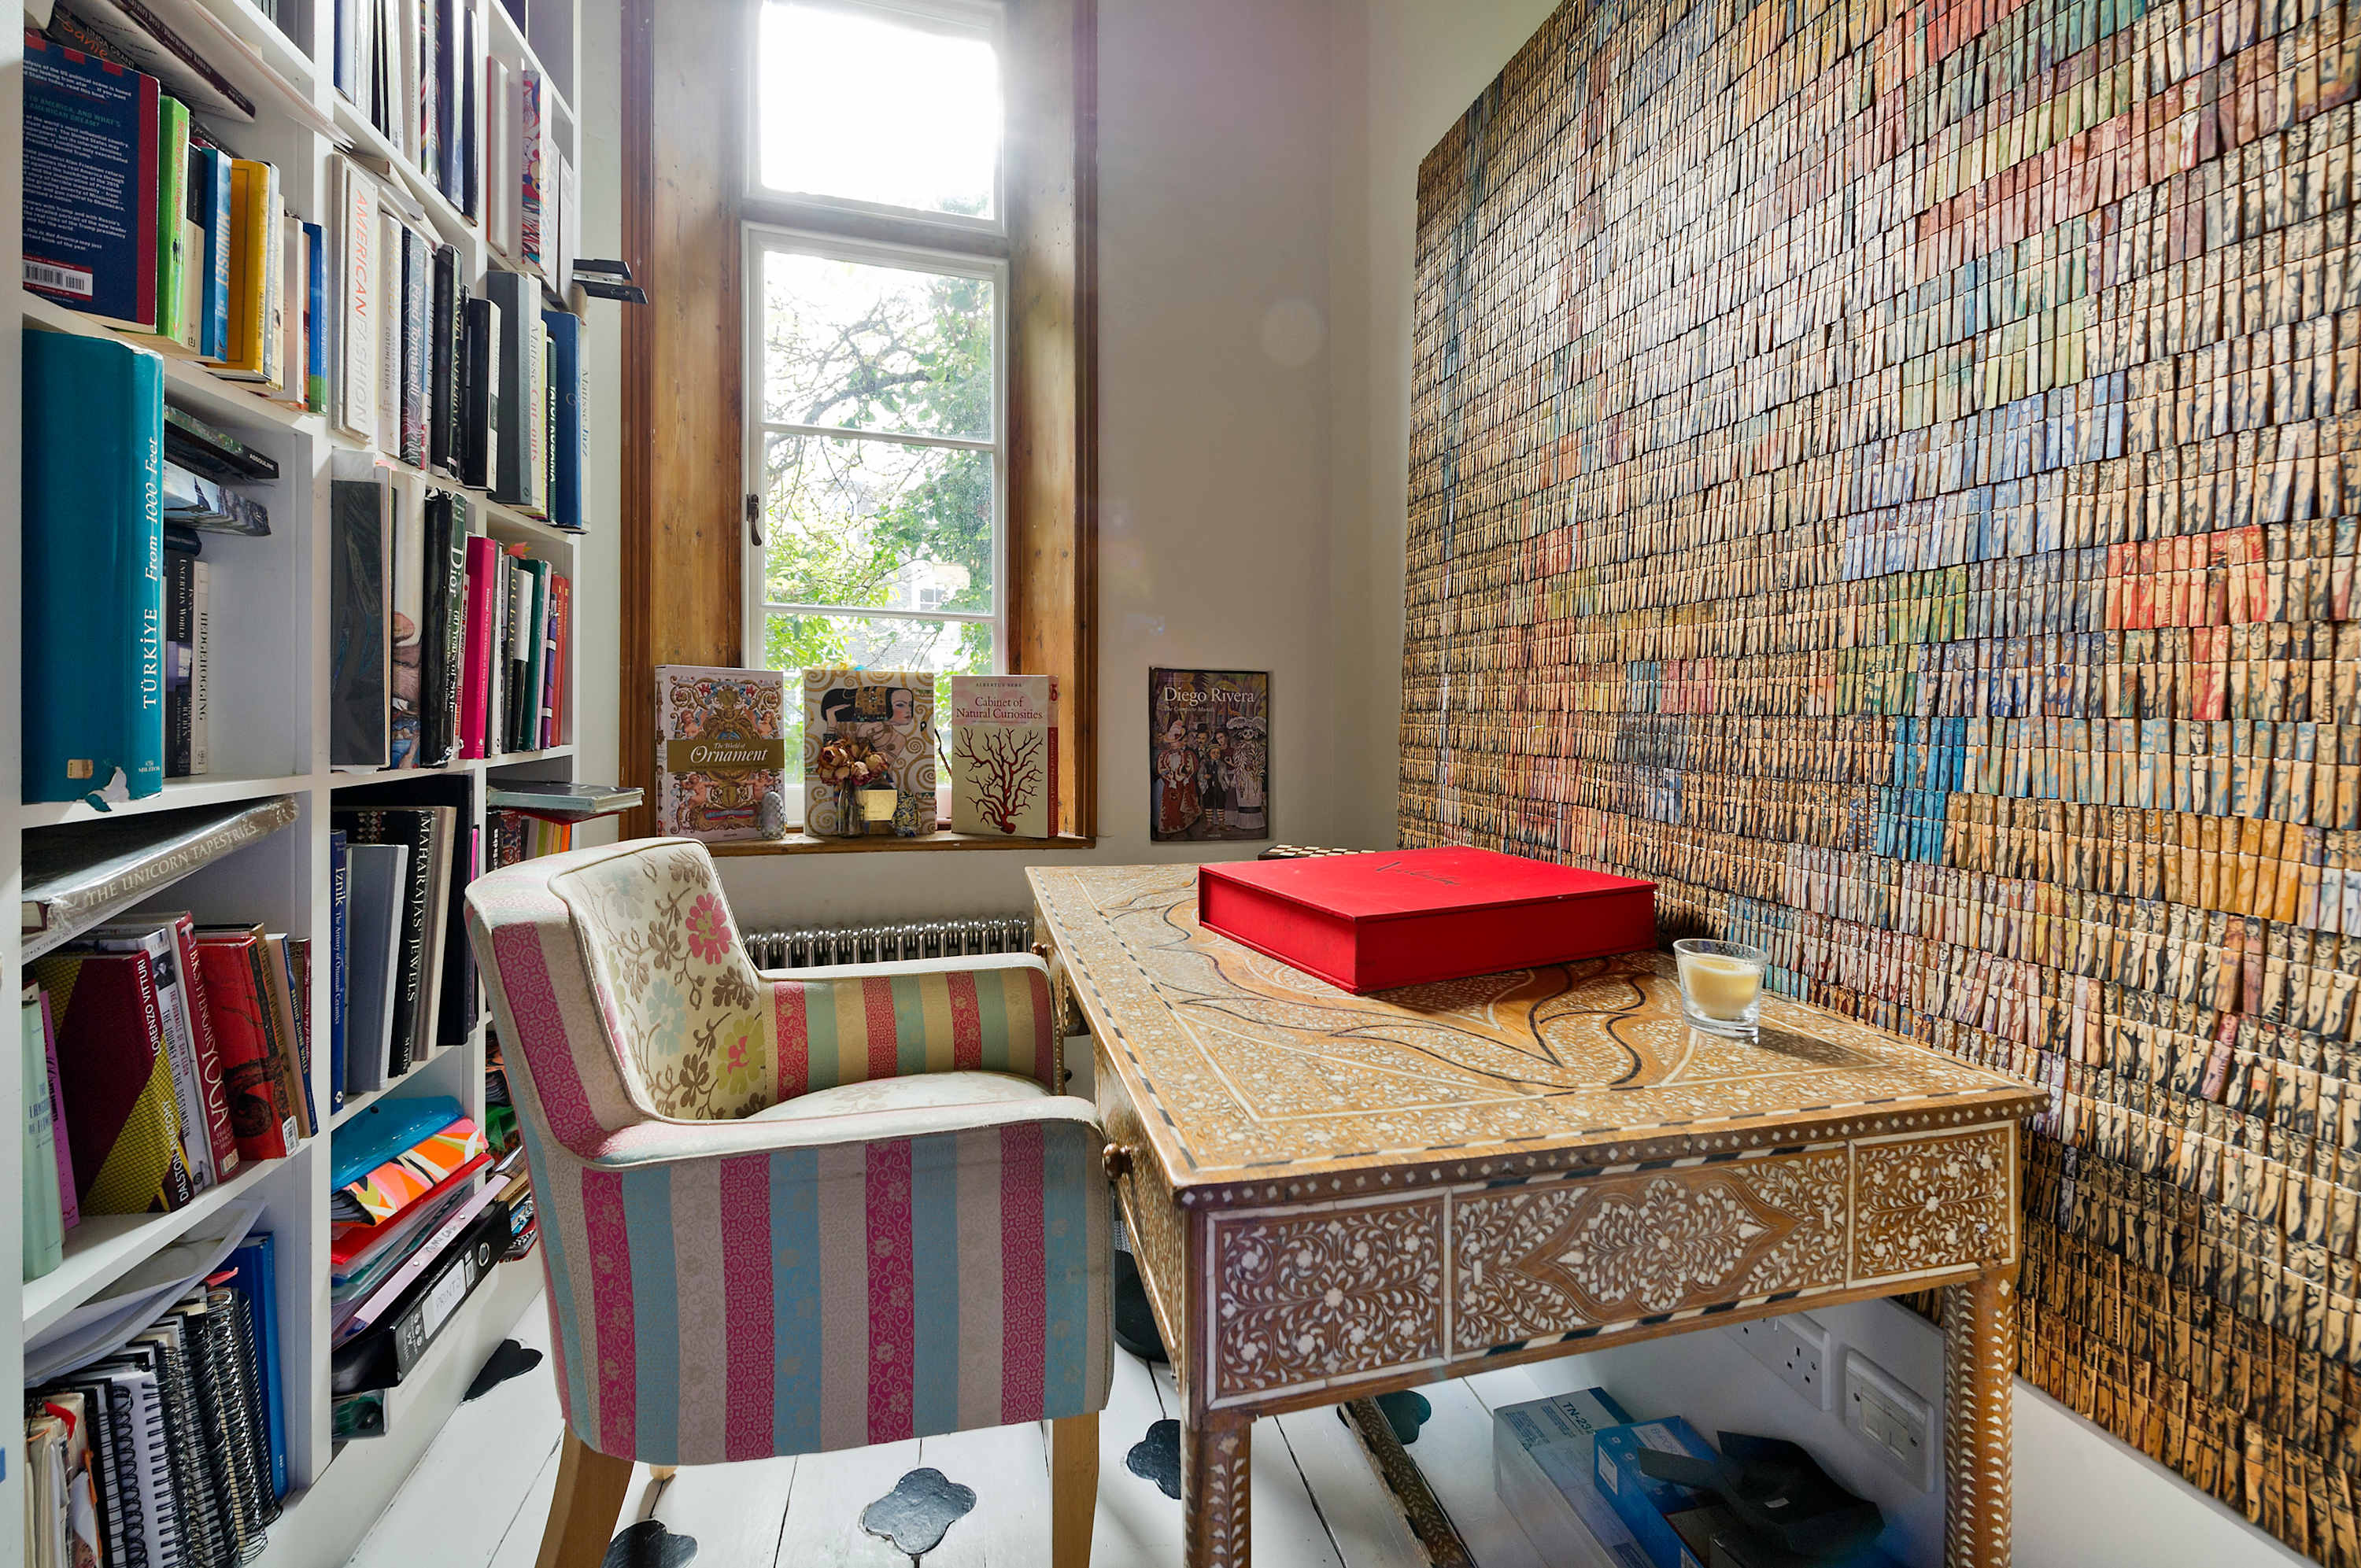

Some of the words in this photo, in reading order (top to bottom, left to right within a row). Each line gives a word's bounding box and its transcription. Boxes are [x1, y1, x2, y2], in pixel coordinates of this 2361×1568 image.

[87, 26, 109, 48] LINDA
[216, 208, 231, 290] MINDSET
[354, 190, 368, 316] AMERICAN
[412, 283, 423, 322] Fred
[355, 316, 368, 423] FASHION
[409, 325, 423, 397] Tomaselli
[145, 437, 157, 474] Feet
[145, 482, 157, 525] 1000
[145, 535, 157, 581] From
[449, 547, 464, 597] Dior
[179, 559, 187, 603] UNCERTAIN
[178, 608, 187, 638] WORLD
[453, 610, 460, 625] 60
[140, 609, 157, 709] TÜRKİYE
[199, 611, 208, 721] HEDGEHOGGING
[956, 708, 991, 718] Natural
[993, 708, 1044, 719] Curiosities
[975, 696, 1011, 707] Cabinet
[1013, 695, 1024, 707] of
[1165, 687, 1206, 707] Diego
[1211, 687, 1254, 703] Rivera
[690, 746, 768, 763] Ornament
[87, 882, 118, 907] THE
[122, 851, 190, 891] UNICORN
[191, 821, 259, 860] TAPESTRIES
[413, 815, 431, 934] MAHARAJAS'
[334, 867, 346, 907] Iznik
[137, 959, 153, 1002] VITTURI
[190, 949, 201, 984] B.K.S.
[407, 939, 419, 1002] JEWELS
[145, 1003, 162, 1057] LORENZO
[161, 1009, 172, 1025] THE
[164, 1027, 179, 1059] JOURNEY
[172, 1072, 183, 1089] THE
[201, 1047, 229, 1131] YOGA
[164, 1100, 180, 1152] ANATOMY
[175, 1090, 191, 1138] DESTINATION
[171, 1152, 189, 1202] DALSTON
